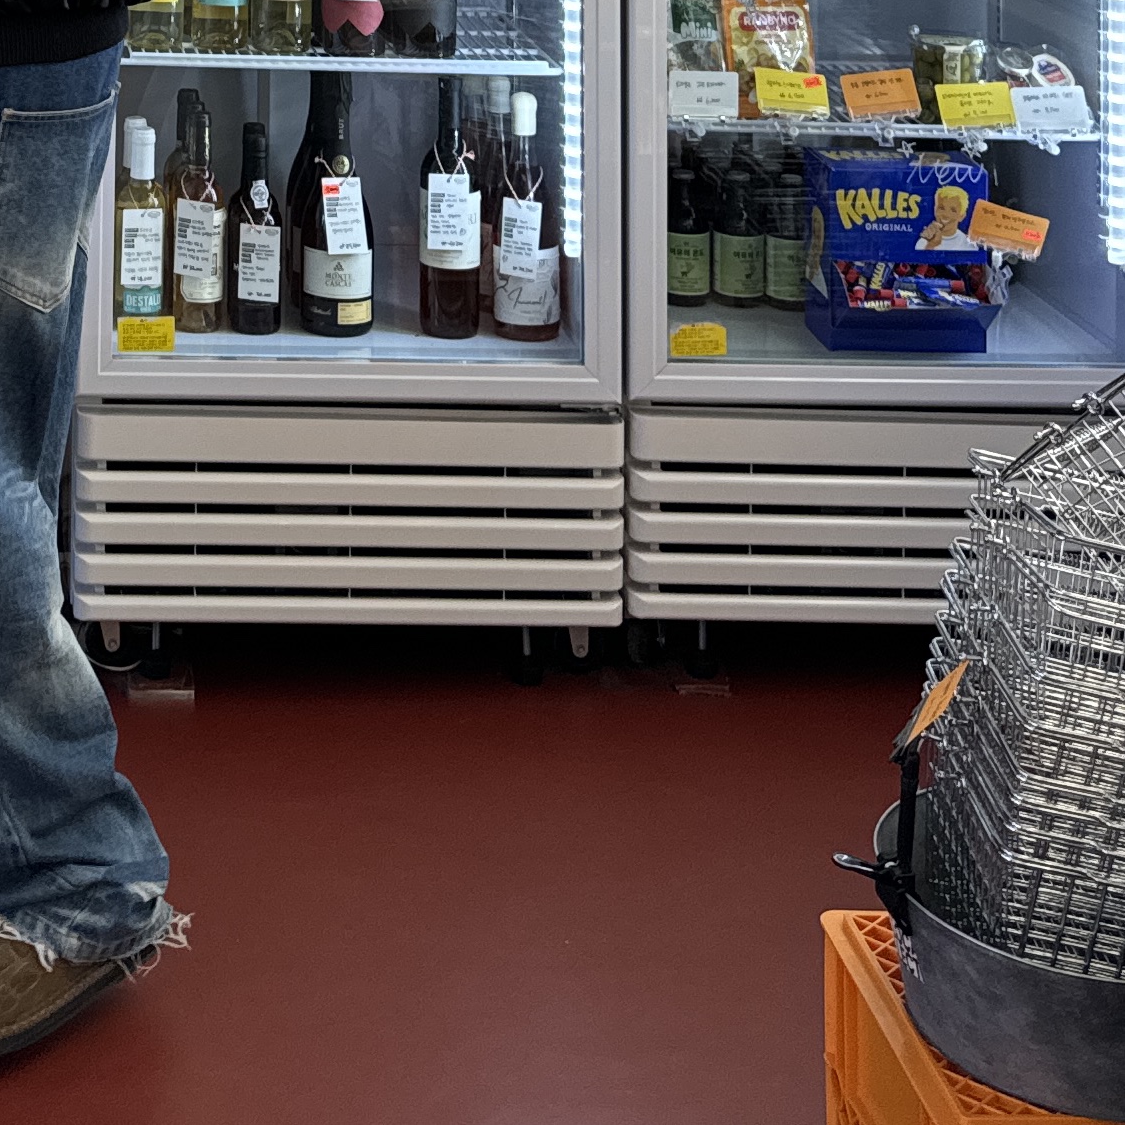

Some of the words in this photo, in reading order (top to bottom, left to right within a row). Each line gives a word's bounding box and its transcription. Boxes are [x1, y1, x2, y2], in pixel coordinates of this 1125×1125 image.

[680, 21, 712, 40] Mini
[835, 187, 922, 230] KALLES
[864, 222, 914, 233] ORIGINAL
